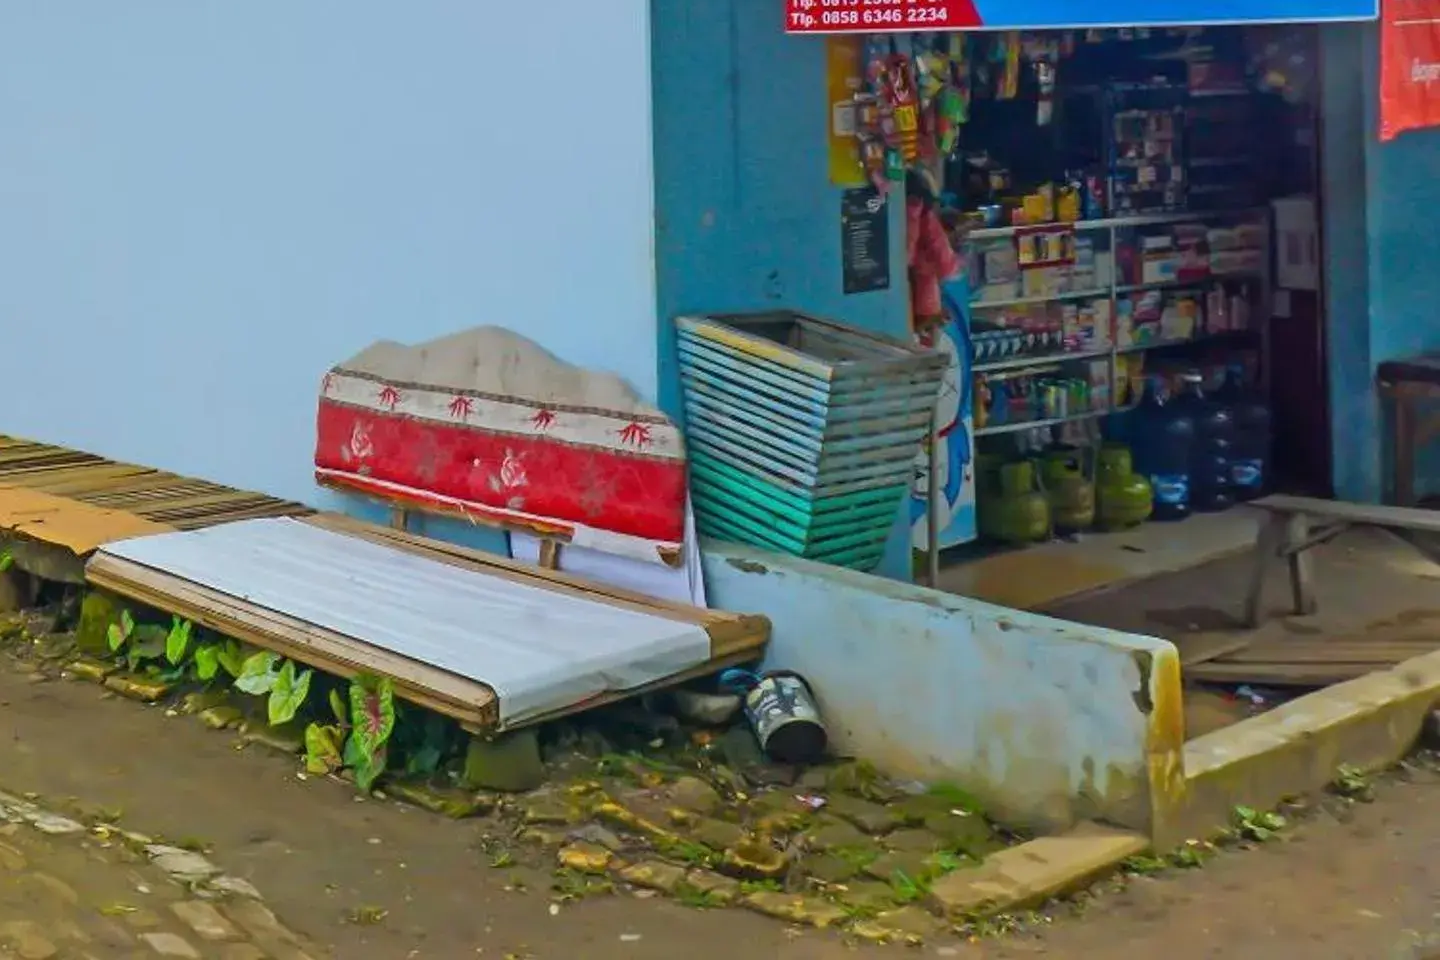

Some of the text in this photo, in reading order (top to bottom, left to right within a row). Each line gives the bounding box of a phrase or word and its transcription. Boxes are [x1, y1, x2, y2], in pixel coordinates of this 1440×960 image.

[821, 11, 859, 25] 0858
[862, 8, 902, 24] 6346
[907, 6, 948, 22] 2234
